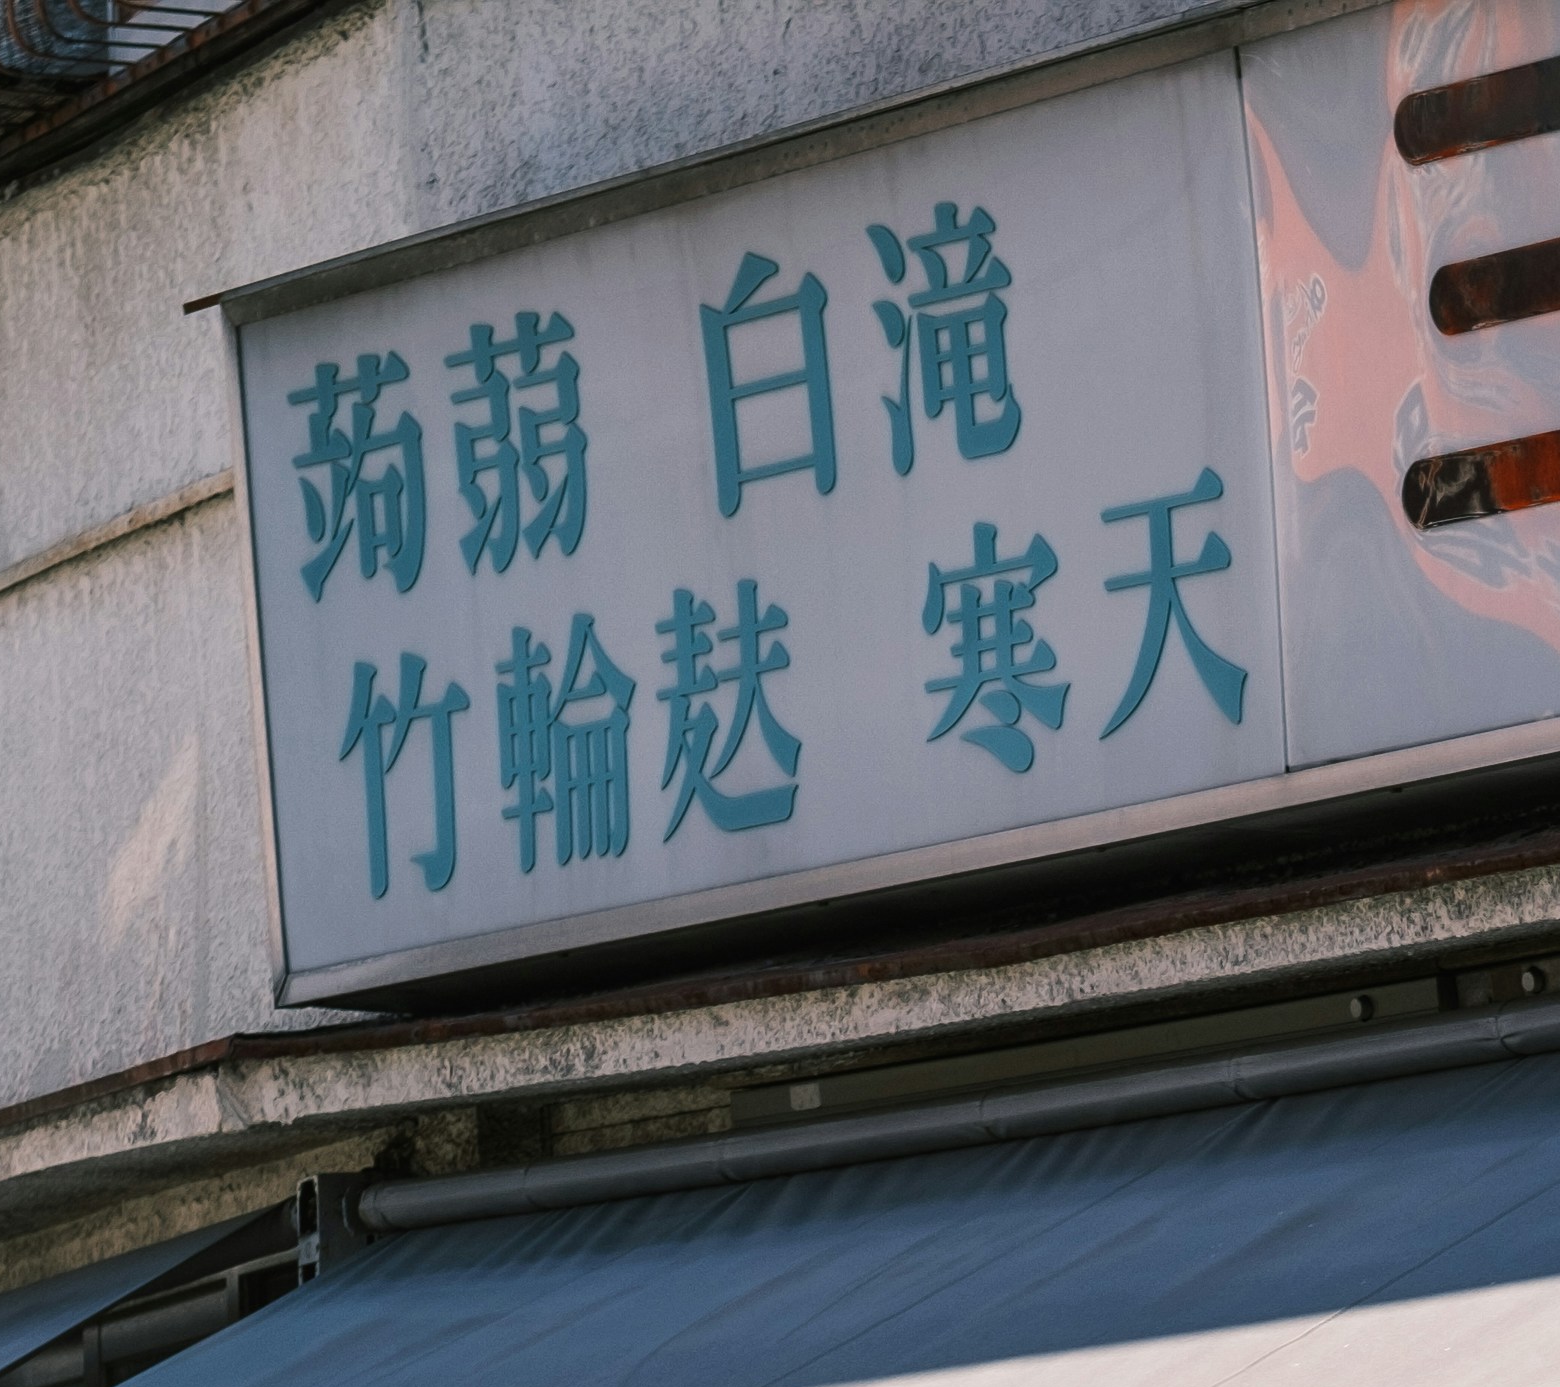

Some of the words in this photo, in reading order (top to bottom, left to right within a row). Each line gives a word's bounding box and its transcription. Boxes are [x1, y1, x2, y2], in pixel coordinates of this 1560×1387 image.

[286, 311, 588, 602] 蒟蒻
[699, 200, 1022, 518] 白滝
[920, 466, 1248, 772] 寒天
